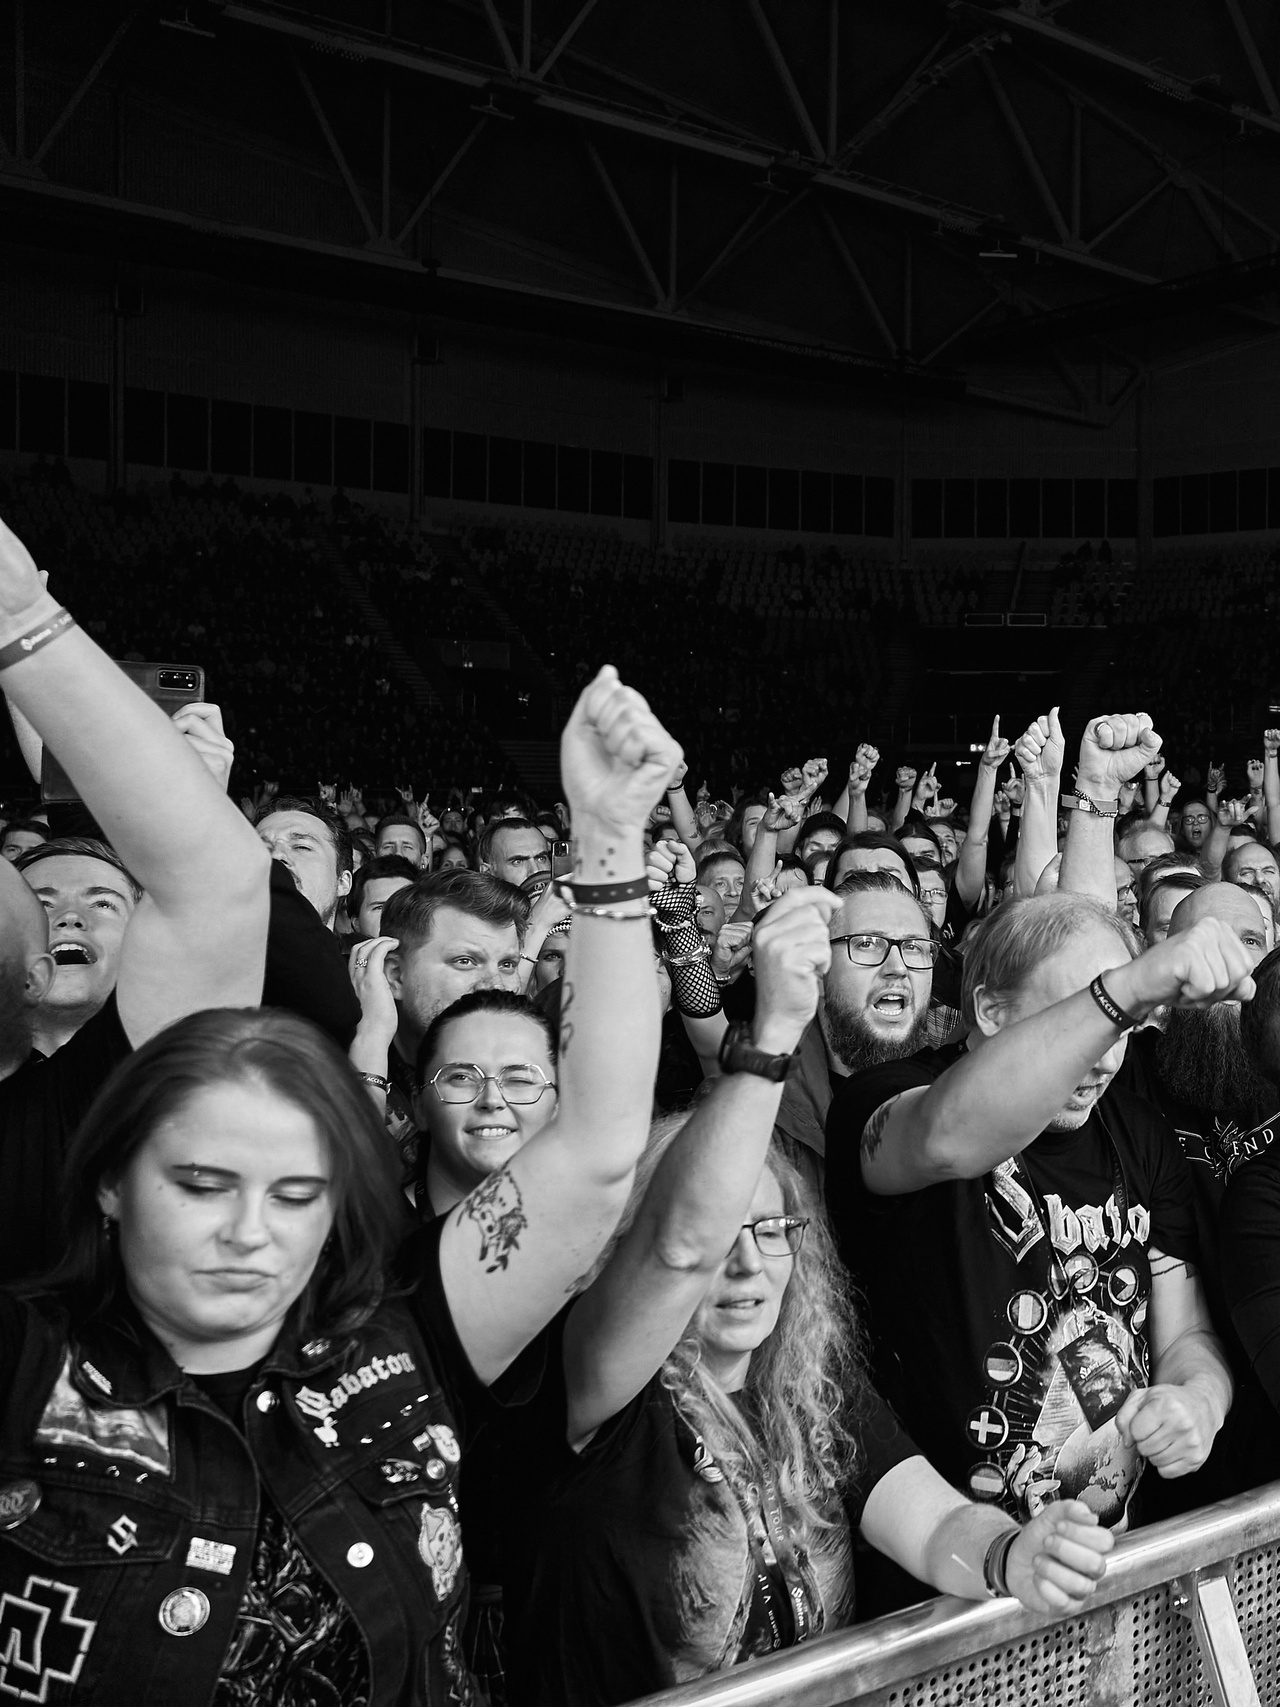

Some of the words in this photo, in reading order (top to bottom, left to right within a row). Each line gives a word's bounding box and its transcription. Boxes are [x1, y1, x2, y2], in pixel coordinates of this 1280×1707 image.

[1098, 996, 1119, 1019] ACCESS
[295, 1352, 416, 1420] Sabaton
[768, 1507, 785, 1543] TOUR
[790, 1586, 805, 1628] Sabaton
